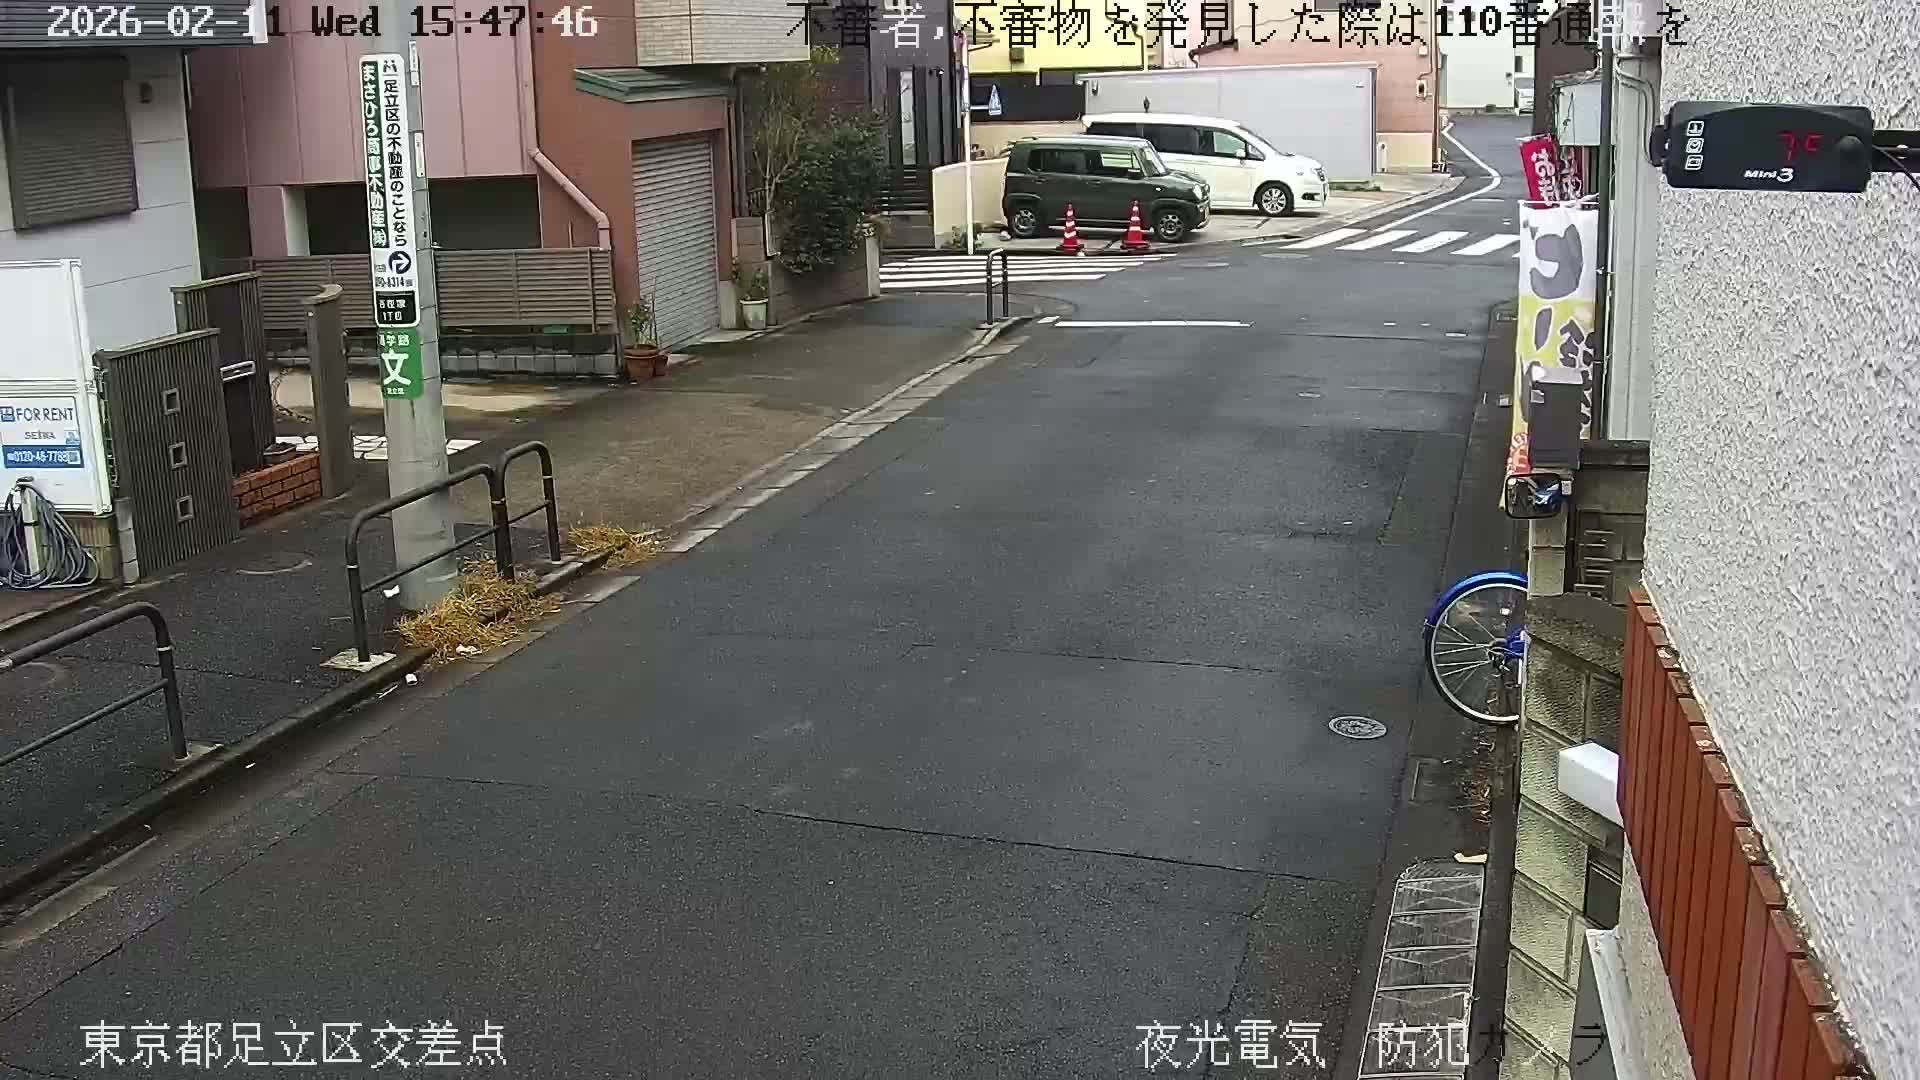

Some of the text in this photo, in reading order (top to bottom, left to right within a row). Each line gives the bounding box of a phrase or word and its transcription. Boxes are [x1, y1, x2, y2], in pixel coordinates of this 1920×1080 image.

[381, 348, 411, 386] 文
[16, 407, 41, 421] FOR
[43, 407, 74, 421] RENT
